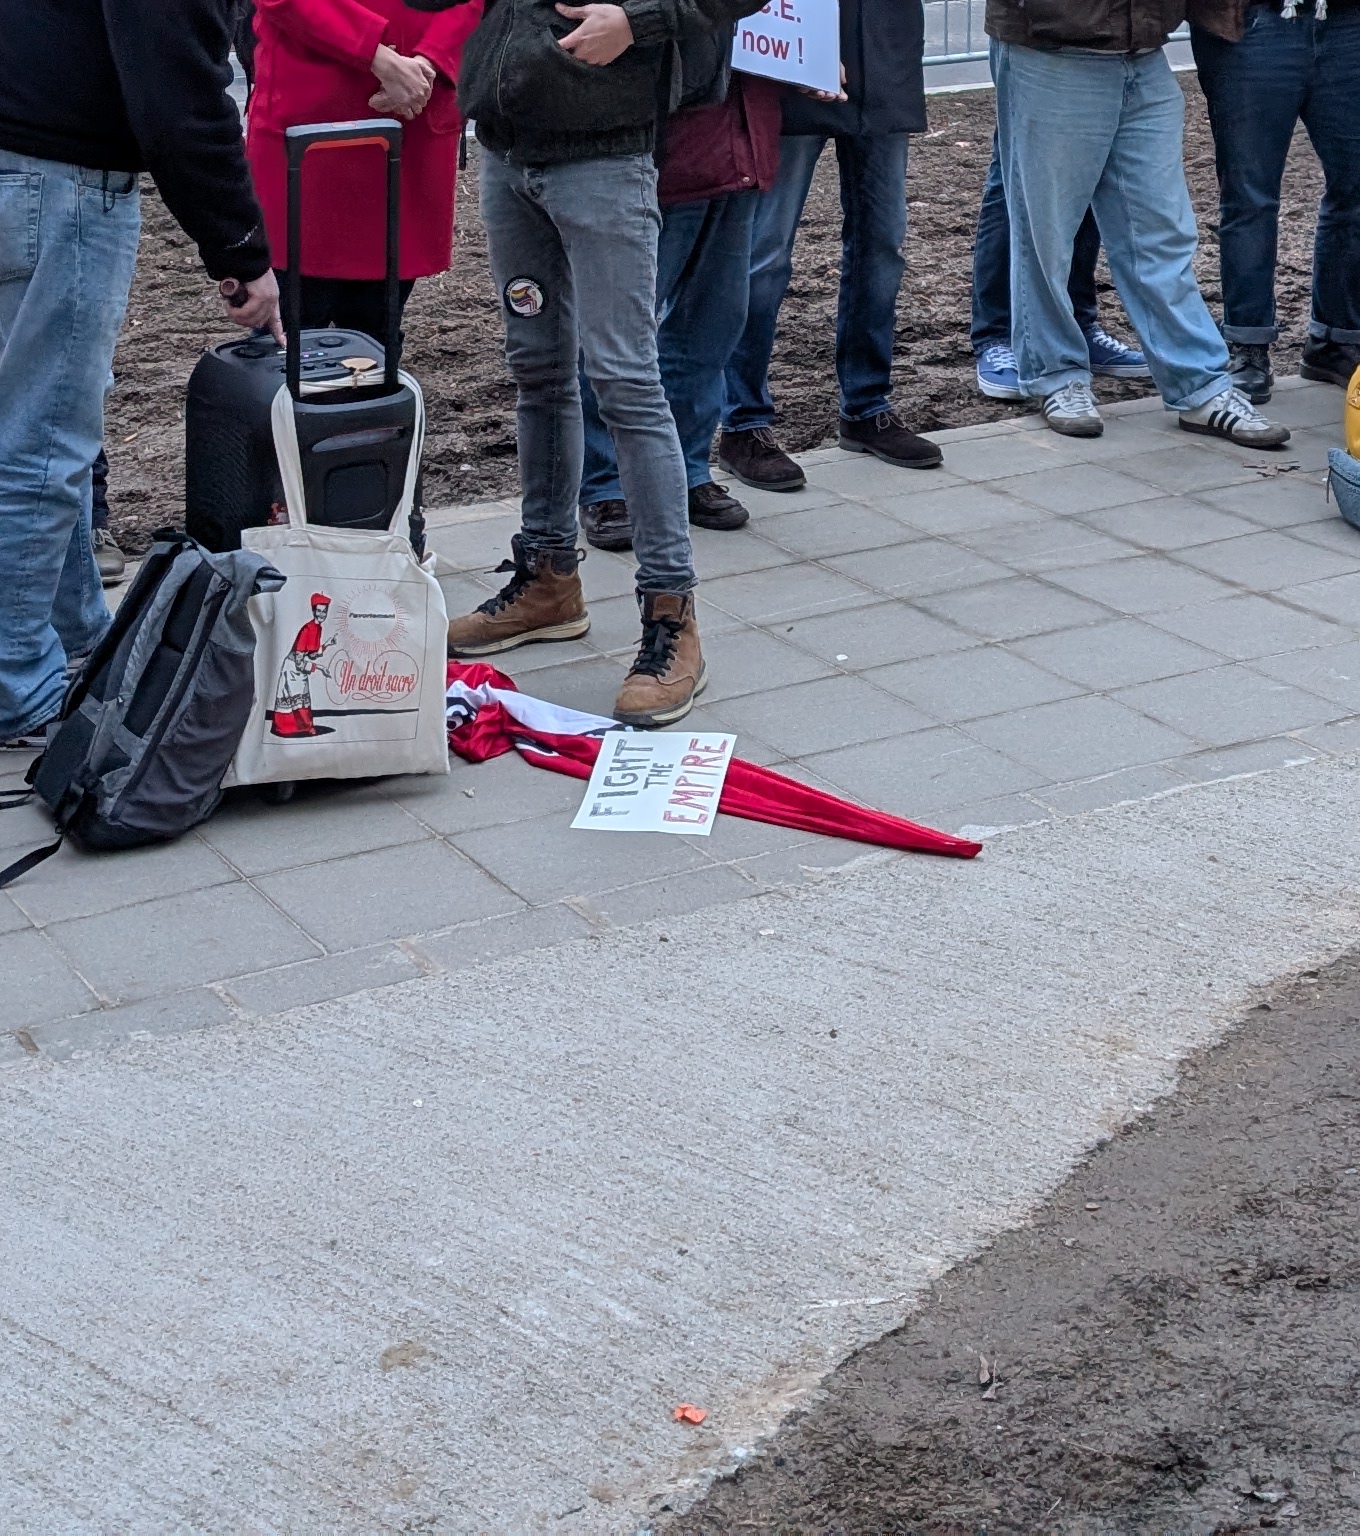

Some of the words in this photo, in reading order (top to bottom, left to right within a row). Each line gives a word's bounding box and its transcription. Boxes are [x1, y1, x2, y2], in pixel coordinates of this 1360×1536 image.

[742, 29, 791, 61] now
[358, 660, 388, 692] droit
[589, 737, 654, 817] FIGHT
[642, 762, 675, 790] THE
[662, 737, 729, 825] EMPIRE
